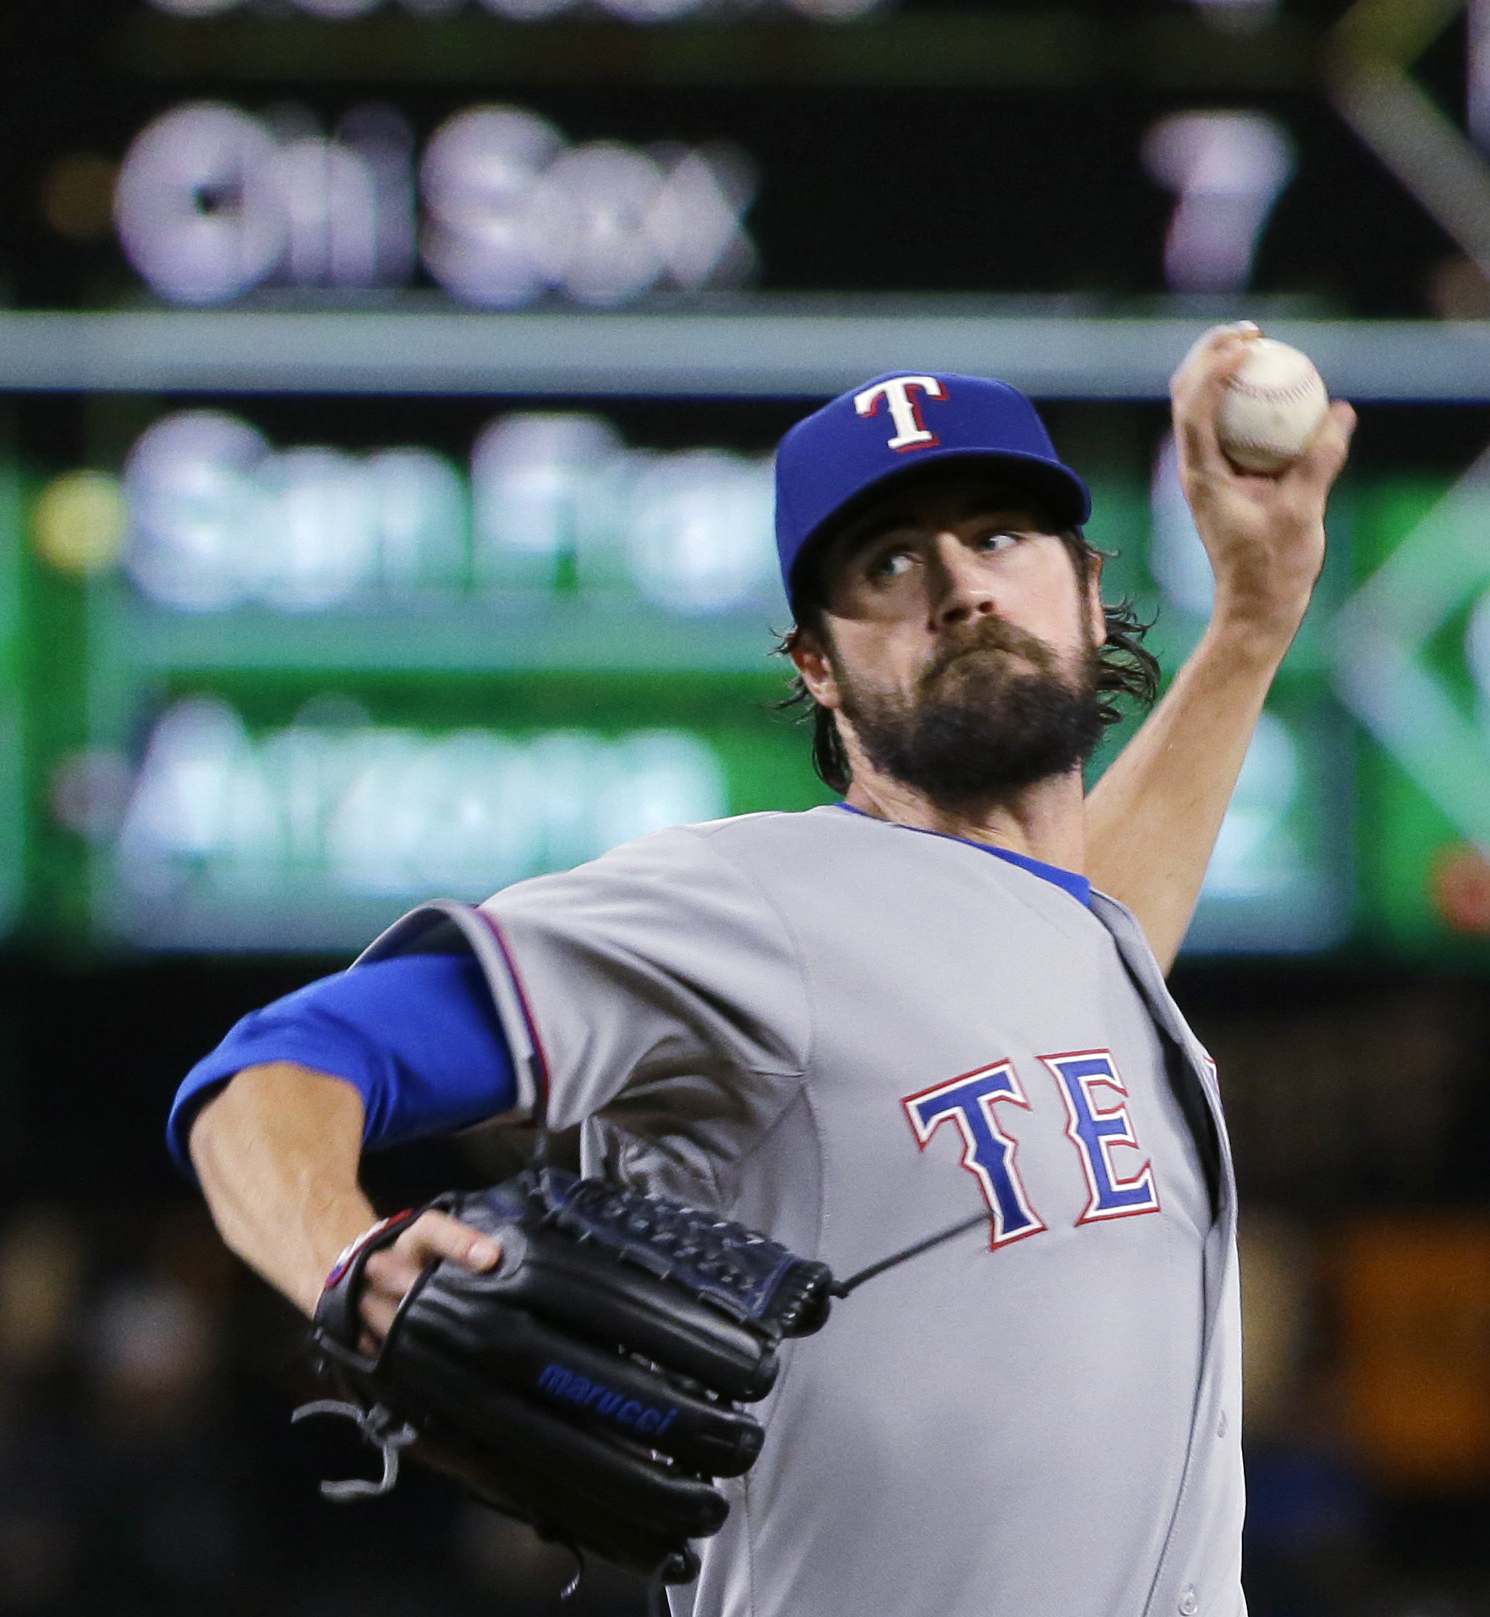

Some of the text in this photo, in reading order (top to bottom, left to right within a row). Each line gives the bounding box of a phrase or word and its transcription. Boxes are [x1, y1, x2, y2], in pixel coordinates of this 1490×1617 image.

[1142, 108, 1294, 294] 7
[853, 375, 950, 453] T
[122, 408, 468, 614] San
[537, 1362, 679, 1434] marucci
